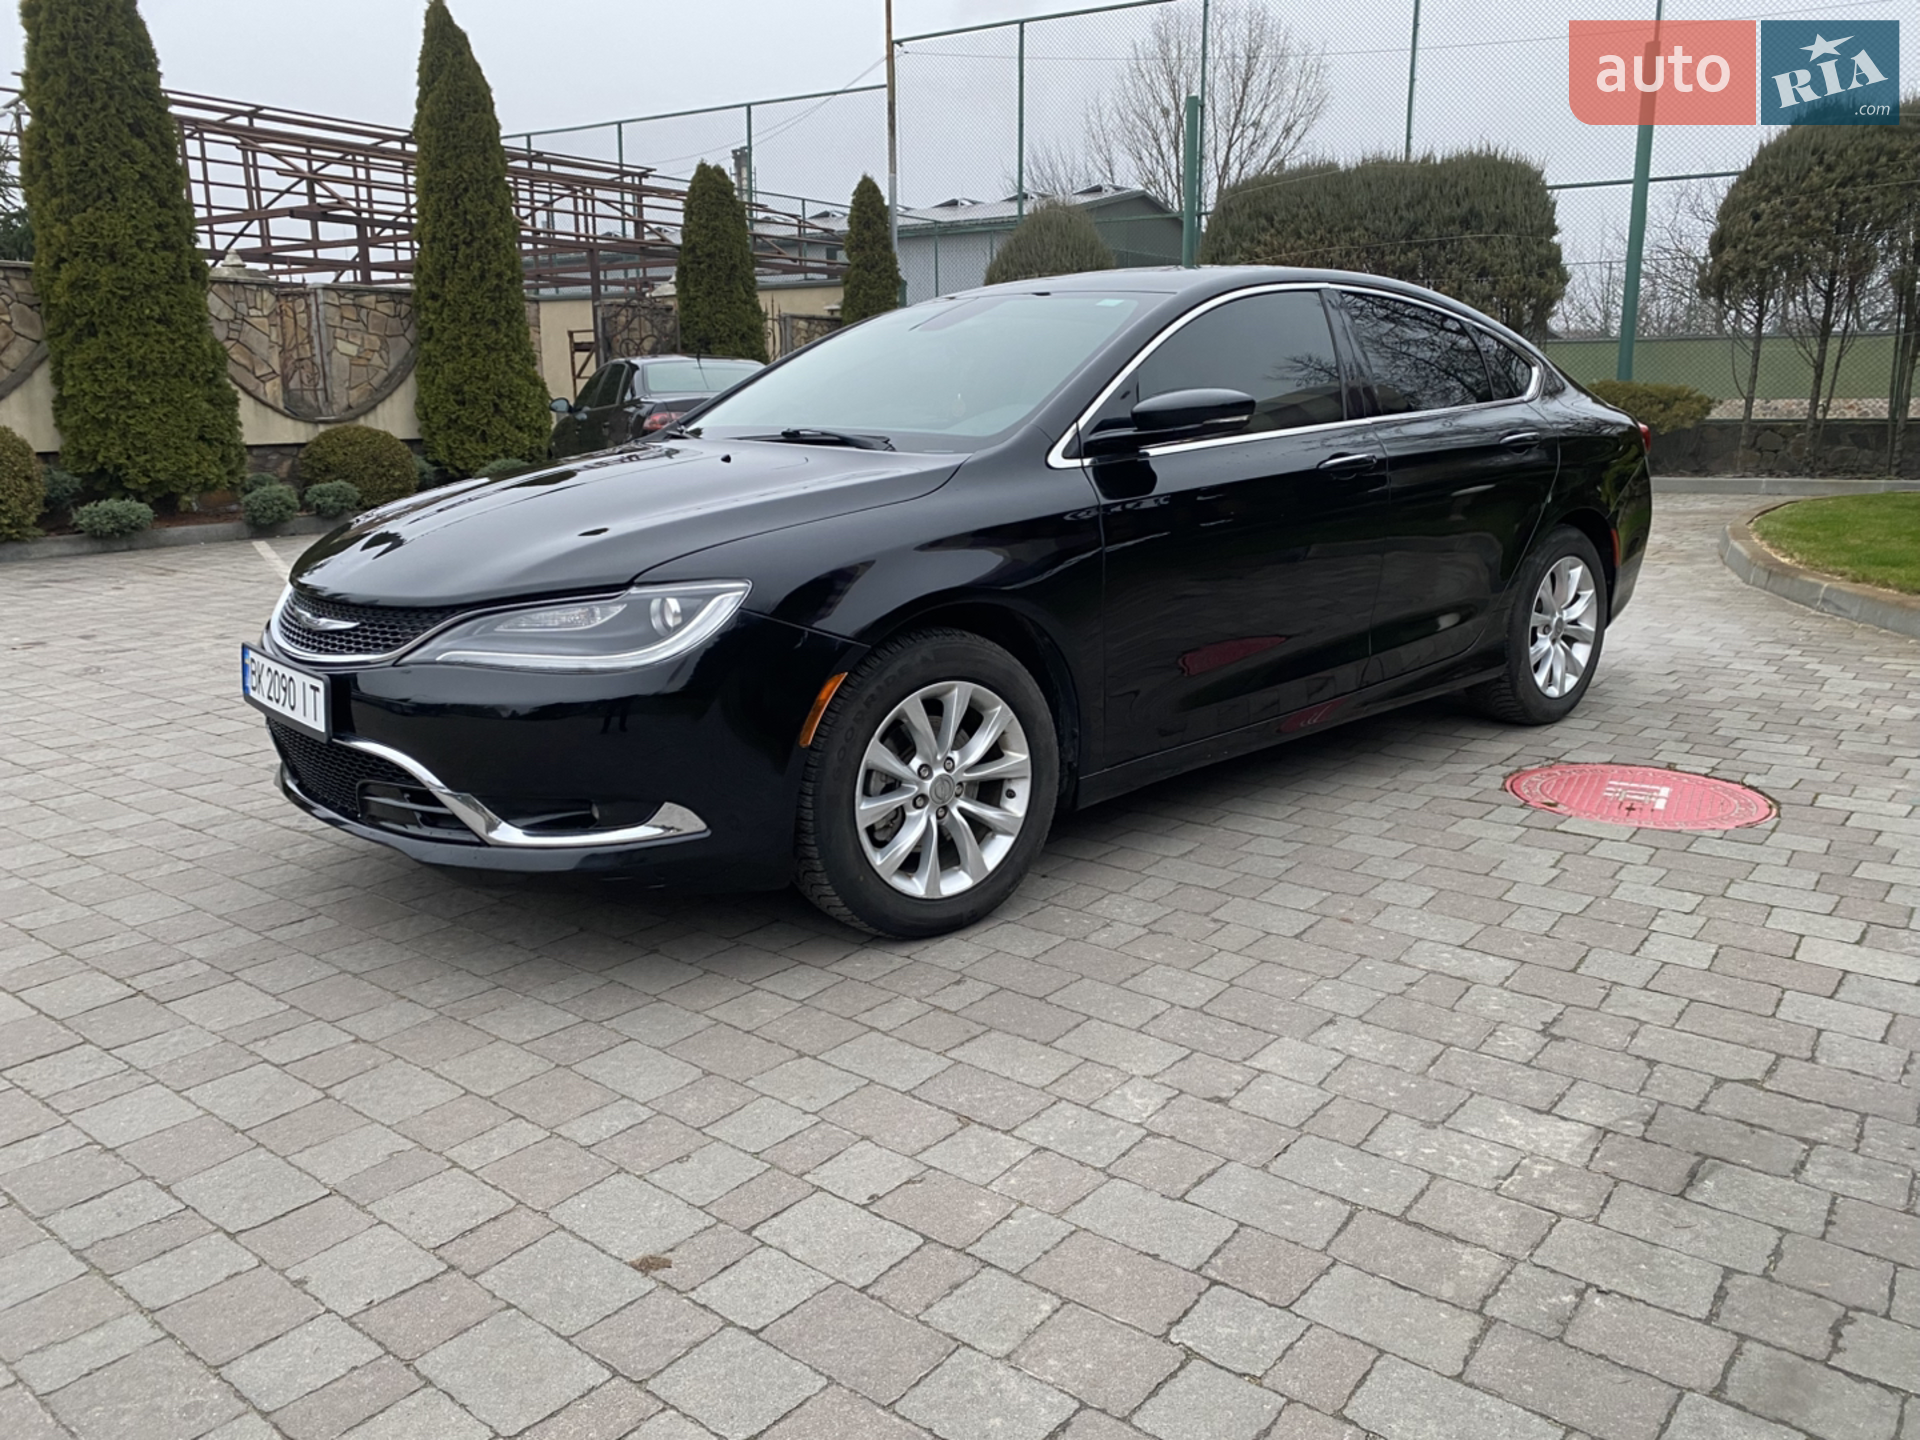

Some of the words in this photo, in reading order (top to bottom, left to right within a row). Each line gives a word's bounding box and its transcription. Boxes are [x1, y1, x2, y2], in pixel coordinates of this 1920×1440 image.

[250, 657, 265, 698] BK
[266, 667, 296, 711] 2090
[302, 681, 320, 722] IT
